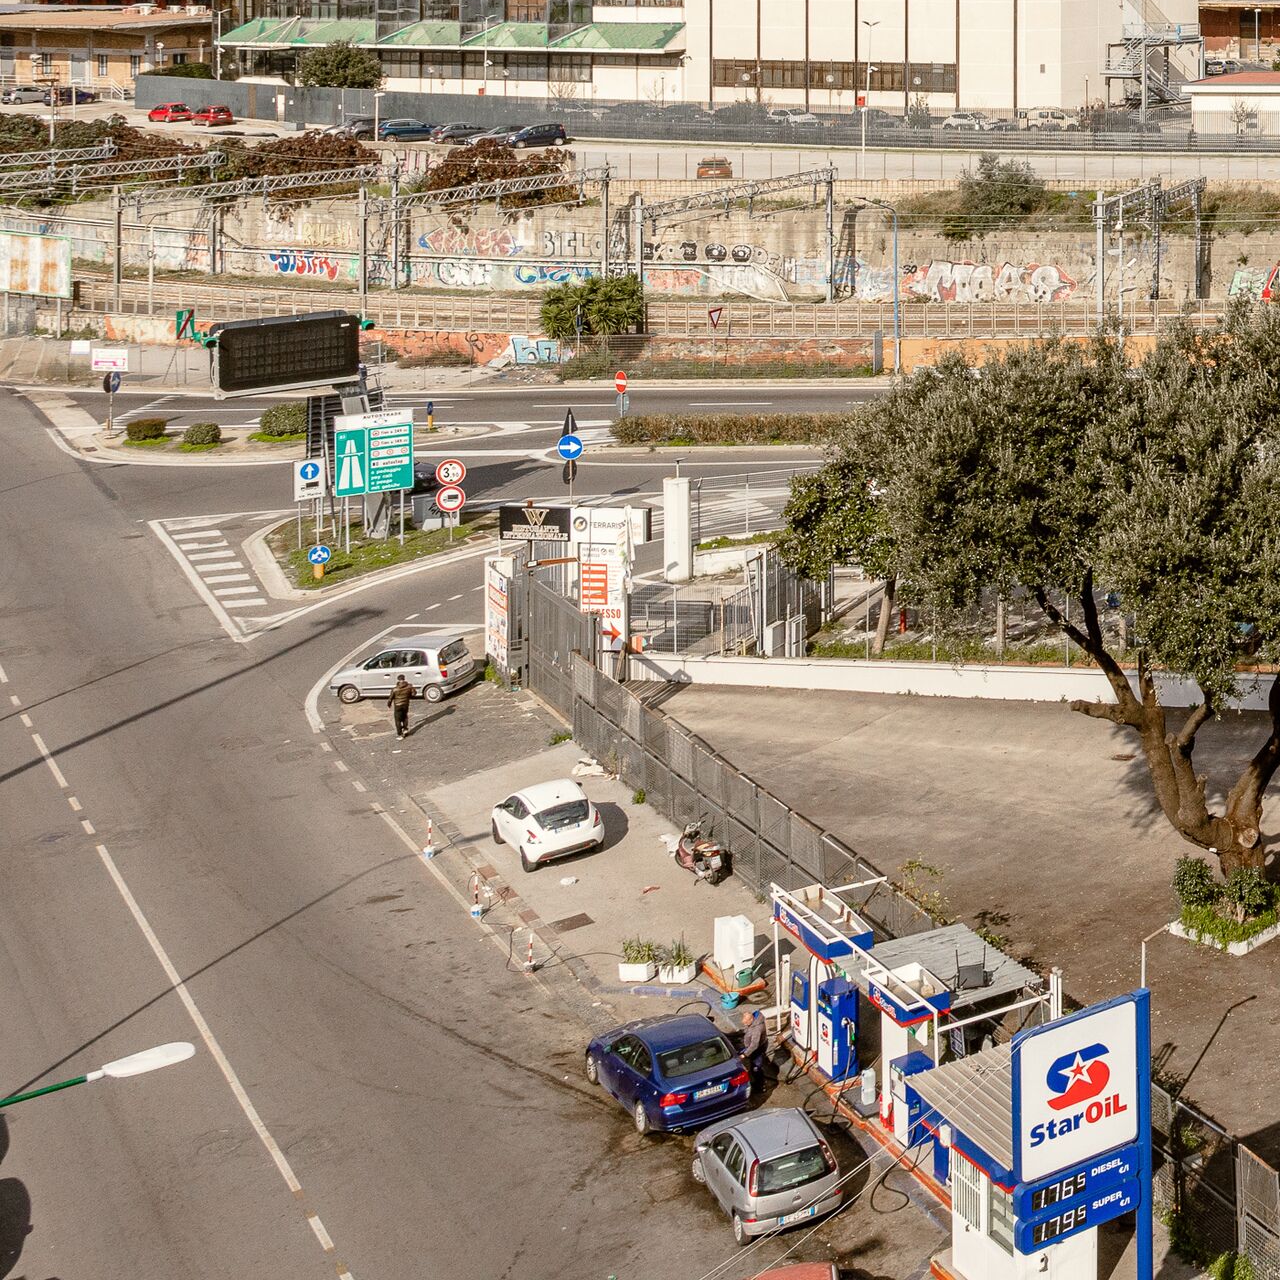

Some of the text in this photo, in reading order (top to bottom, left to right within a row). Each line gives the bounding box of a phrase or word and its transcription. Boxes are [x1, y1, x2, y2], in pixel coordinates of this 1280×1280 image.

[363, 411, 402, 420] AUTOSTRADE
[1090, 1158, 1123, 1177] DIESEL
[1091, 1191, 1123, 1210] SUPER
